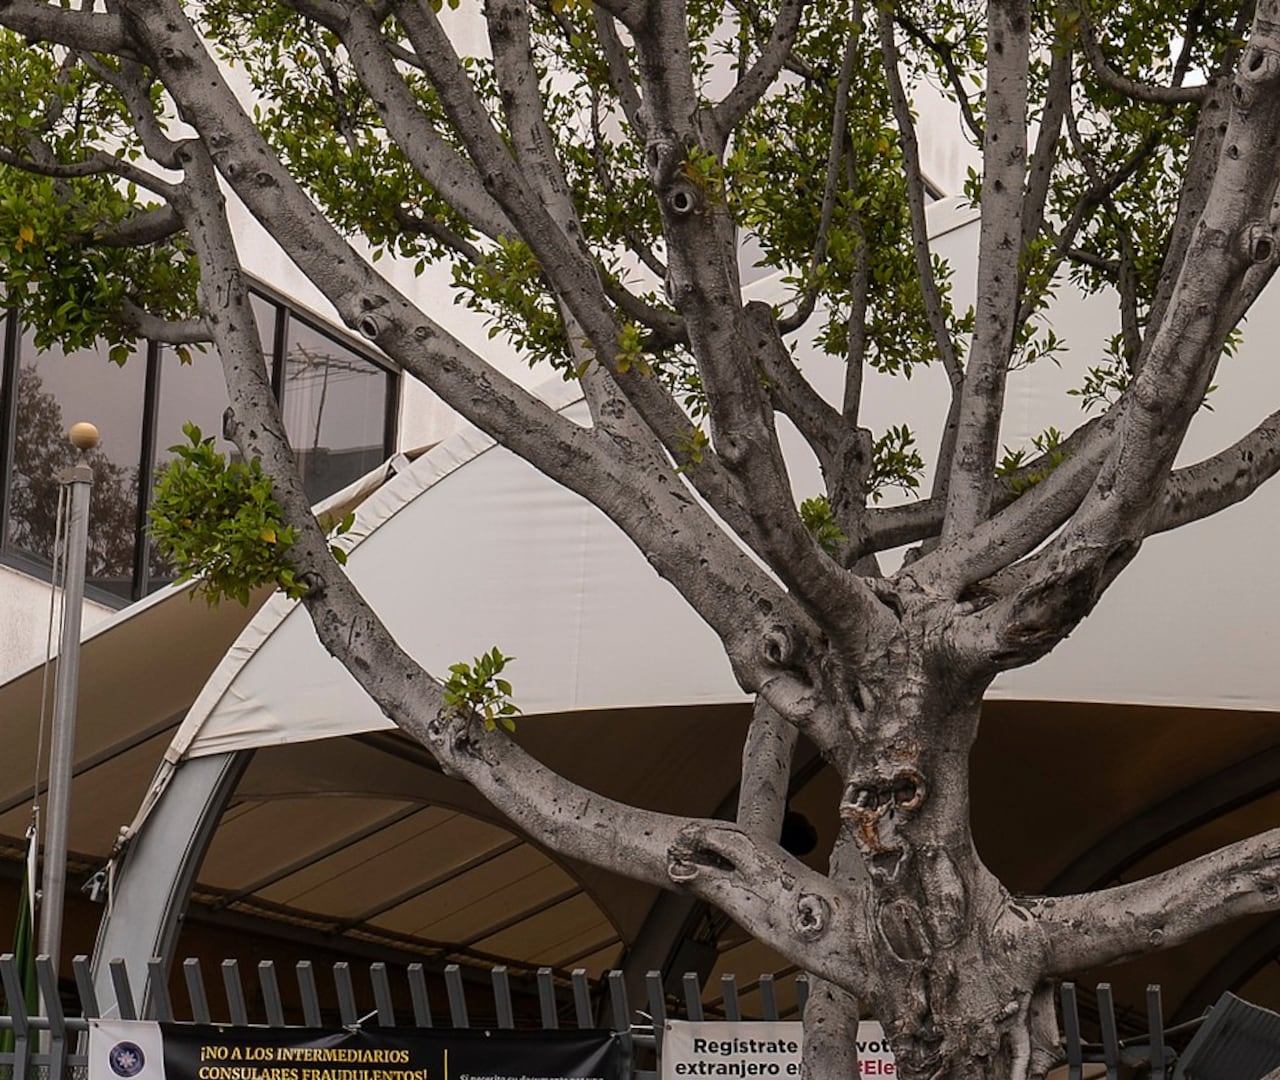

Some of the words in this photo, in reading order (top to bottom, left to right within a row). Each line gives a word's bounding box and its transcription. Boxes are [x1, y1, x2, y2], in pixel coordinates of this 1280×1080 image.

[856, 1039, 894, 1052] vot
[201, 1046, 228, 1061] ¡NO
[231, 1047, 242, 1060] A
[246, 1047, 273, 1060] LOS
[277, 1048, 409, 1063] INTERMEDIARIOS
[199, 1066, 298, 1080] CONSULARES
[676, 1060, 780, 1078] extranjero
